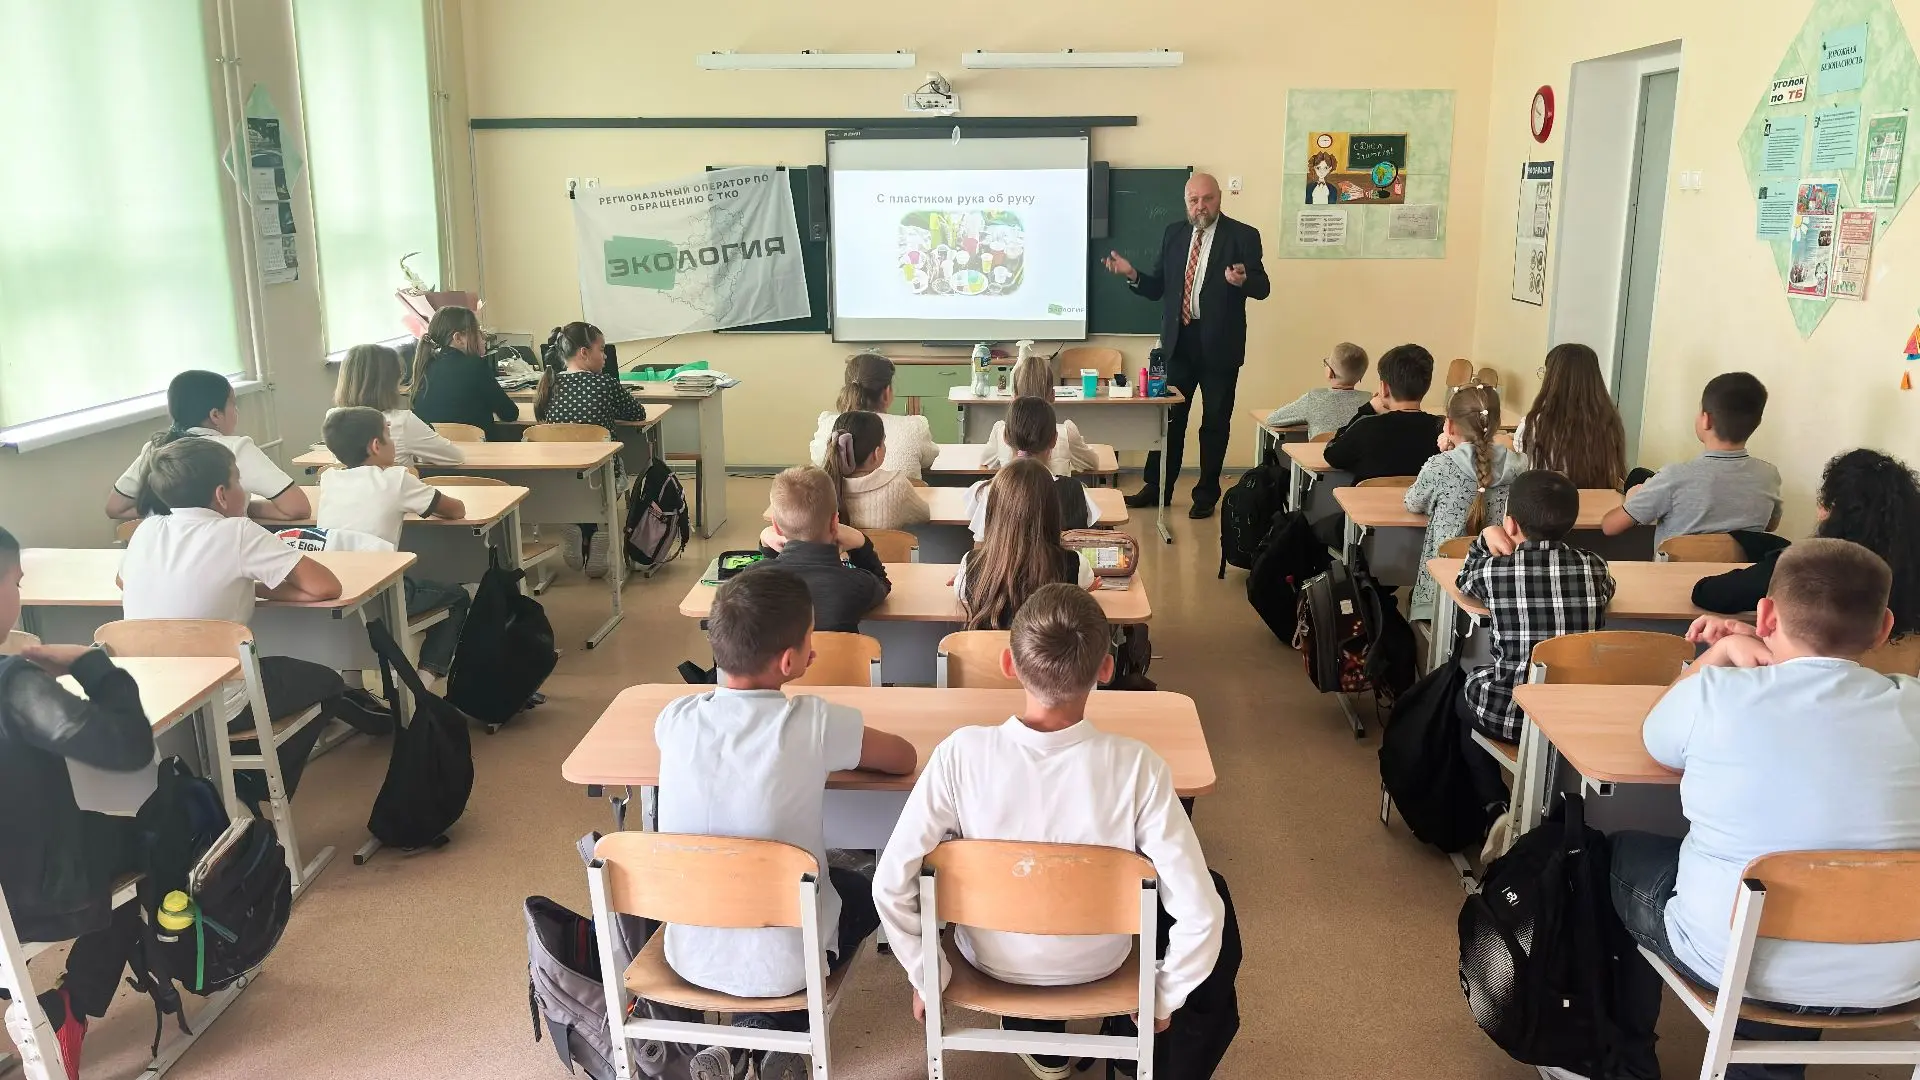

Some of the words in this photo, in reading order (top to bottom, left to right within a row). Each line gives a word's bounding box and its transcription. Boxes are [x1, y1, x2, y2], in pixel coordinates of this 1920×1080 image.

[1772, 77, 1805, 92] уголок
[1770, 94, 1784, 102] по
[1788, 89, 1803, 100] ТБ
[599, 186, 690, 205] РЕГИОНАЛЬНЫЙ
[693, 177, 751, 193] ОПЕРАТОР
[753, 174, 769, 184] ПО
[876, 193, 885, 203] С
[889, 195, 953, 204] пластиком
[957, 195, 985, 205] рука
[988, 193, 1004, 203] об
[1008, 195, 1035, 205] руку
[630, 195, 704, 212] ОБРАЩЕНИЮ
[707, 193, 714, 201] С
[717, 189, 739, 200] ТКО
[607, 236, 786, 278] ЭКОЛОГИЯ
